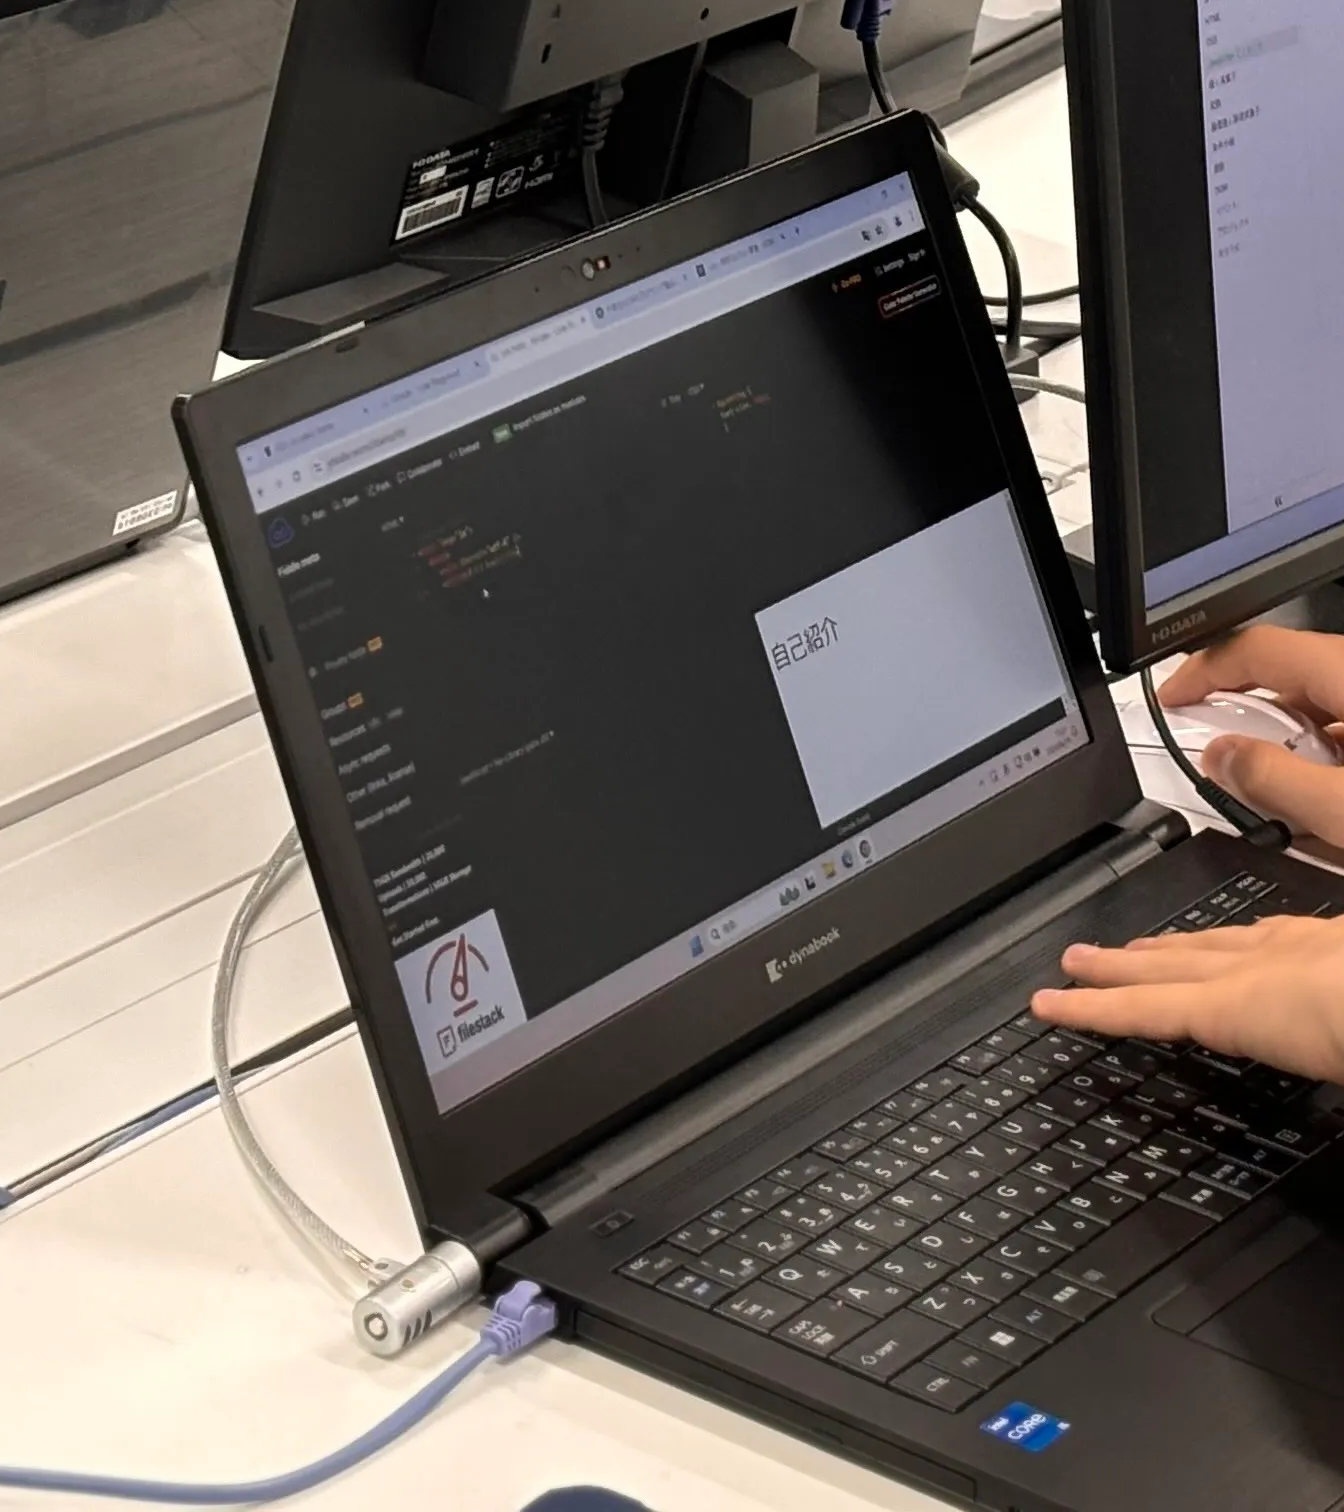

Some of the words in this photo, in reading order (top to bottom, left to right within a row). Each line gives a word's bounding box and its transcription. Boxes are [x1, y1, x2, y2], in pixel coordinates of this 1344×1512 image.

[769, 615, 839, 672] 自己紹介
[789, 926, 841, 966] dynabook
[457, 1004, 505, 1044] filestack
[1106, 1056, 1120, 1064] P
[1073, 1076, 1092, 1086] O
[985, 1098, 1000, 1106] 8
[1136, 1095, 1155, 1103] L
[948, 1121, 962, 1130] 7
[1101, 1115, 1121, 1126] K
[1001, 1122, 1022, 1133] U
[913, 1145, 928, 1153] 6
[1070, 1139, 1085, 1149] J
[966, 1147, 984, 1157] Y
[1142, 1146, 1167, 1159] M
[875, 1168, 891, 1177] 5
[1031, 1163, 1053, 1174] H
[929, 1170, 949, 1179] T
[1106, 1171, 1129, 1183] N
[841, 1192, 856, 1202] 4
[997, 1186, 1018, 1197] G
[892, 1196, 913, 1206] R
[1071, 1197, 1091, 1207] B
[799, 1218, 816, 1227] 3
[959, 1212, 974, 1223] F
[855, 1220, 876, 1231] E
[1035, 1220, 1056, 1231] V
[758, 1241, 777, 1253] 2
[921, 1236, 942, 1247] D
[817, 1240, 842, 1255] W
[1001, 1246, 1021, 1257] C
[884, 1262, 903, 1273] S
[779, 1269, 803, 1280] Q
[961, 1272, 983, 1284] X
[848, 1288, 869, 1299] A
[923, 1297, 946, 1309] Z
